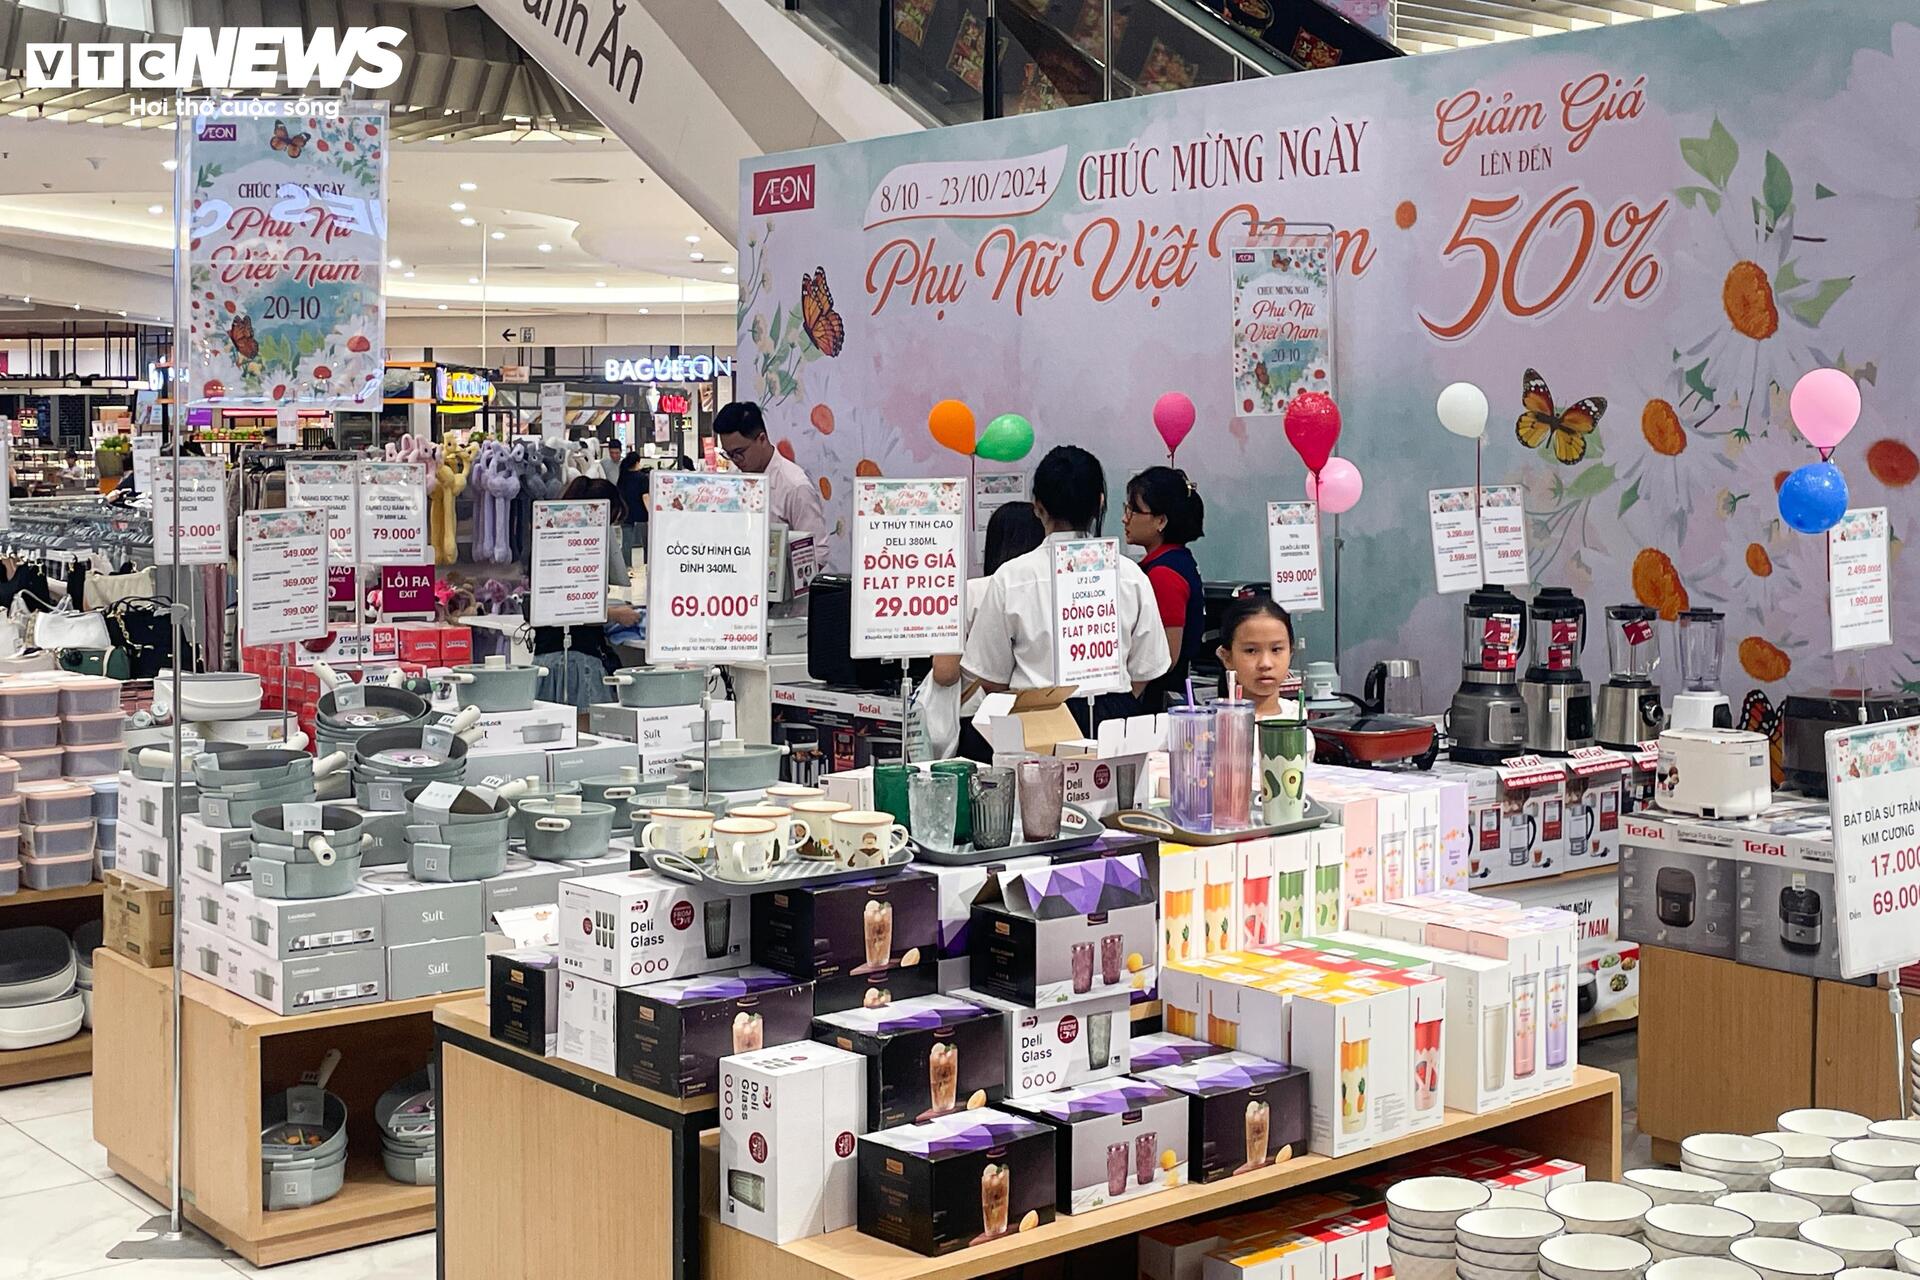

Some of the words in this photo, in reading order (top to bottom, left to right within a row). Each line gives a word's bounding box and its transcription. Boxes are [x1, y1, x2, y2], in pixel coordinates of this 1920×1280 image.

[587, 0, 643, 104] Ăn
[1436, 90, 1545, 167] Giảm
[1560, 73, 1646, 153] Giá
[1079, 142, 1160, 203] CHÚC
[1171, 132, 1264, 193] MỪNG
[1279, 116, 1369, 181] NGÀY
[1480, 149, 1513, 176] LÊN
[1518, 143, 1553, 173] ĐẾN
[239, 183, 271, 198] CHÚC
[314, 182, 346, 198] NGÀY
[880, 184, 920, 212] 8/10
[939, 165, 1048, 207] 23/10/2024
[284, 247, 362, 287] Nam
[864, 237, 968, 320] Phụ
[974, 226, 1069, 316] Nữ
[1073, 217, 1200, 308] Việt
[1418, 185, 1671, 340] 50%
[263, 295, 321, 320] 20-10
[1253, 300, 1285, 322] Phụ
[1289, 299, 1315, 321] Nữ
[1281, 321, 1319, 342] Nam
[870, 521, 880, 530] LY
[933, 520, 954, 529] CAO
[373, 528, 421, 540] 79.000đ
[886, 537, 906, 546] DELI
[909, 537, 937, 546] 380ML
[734, 546, 751, 556] GIA
[864, 546, 919, 570] ĐỒNG
[924, 548, 956, 569] GIÁ
[707, 564, 737, 573] 340ML
[413, 576, 431, 588] RA
[863, 576, 899, 590] FLAT
[907, 575, 955, 589] PRICE
[399, 590, 418, 598] EXIT
[671, 594, 759, 617] 69.000đ
[875, 594, 958, 617] 29.000đ
[1062, 600, 1094, 620] ĐỒNG
[1097, 599, 1116, 617] GIÁ
[1062, 626, 1083, 638] FLAT
[1087, 622, 1116, 635] PRICE
[1070, 640, 1119, 661] 99.000đ
[775, 690, 796, 701] Tefal
[858, 703, 881, 715] Tefal
[644, 729, 661, 739] Suit
[1573, 747, 1607, 760] Tefal
[1640, 742, 1658, 753] Tef
[1503, 756, 1542, 769] Tefal
[1067, 780, 1083, 790] Deli
[1067, 792, 1090, 802] Glass
[1625, 823, 1665, 840] Tefal
[1862, 831, 1879, 846] KIM
[1743, 840, 1788, 857] Tefal
[1873, 883, 1920, 916] 69.00
[422, 910, 445, 922] Suit
[631, 918, 654, 933] Deli
[1588, 918, 1609, 938] NAM
[631, 934, 664, 948] Glass
[428, 962, 450, 975] Suit
[1022, 1033, 1043, 1048] Deli
[1022, 1049, 1052, 1063] Glass
[741, 1079, 749, 1120] Glass
[751, 1081, 759, 1110] Deli
